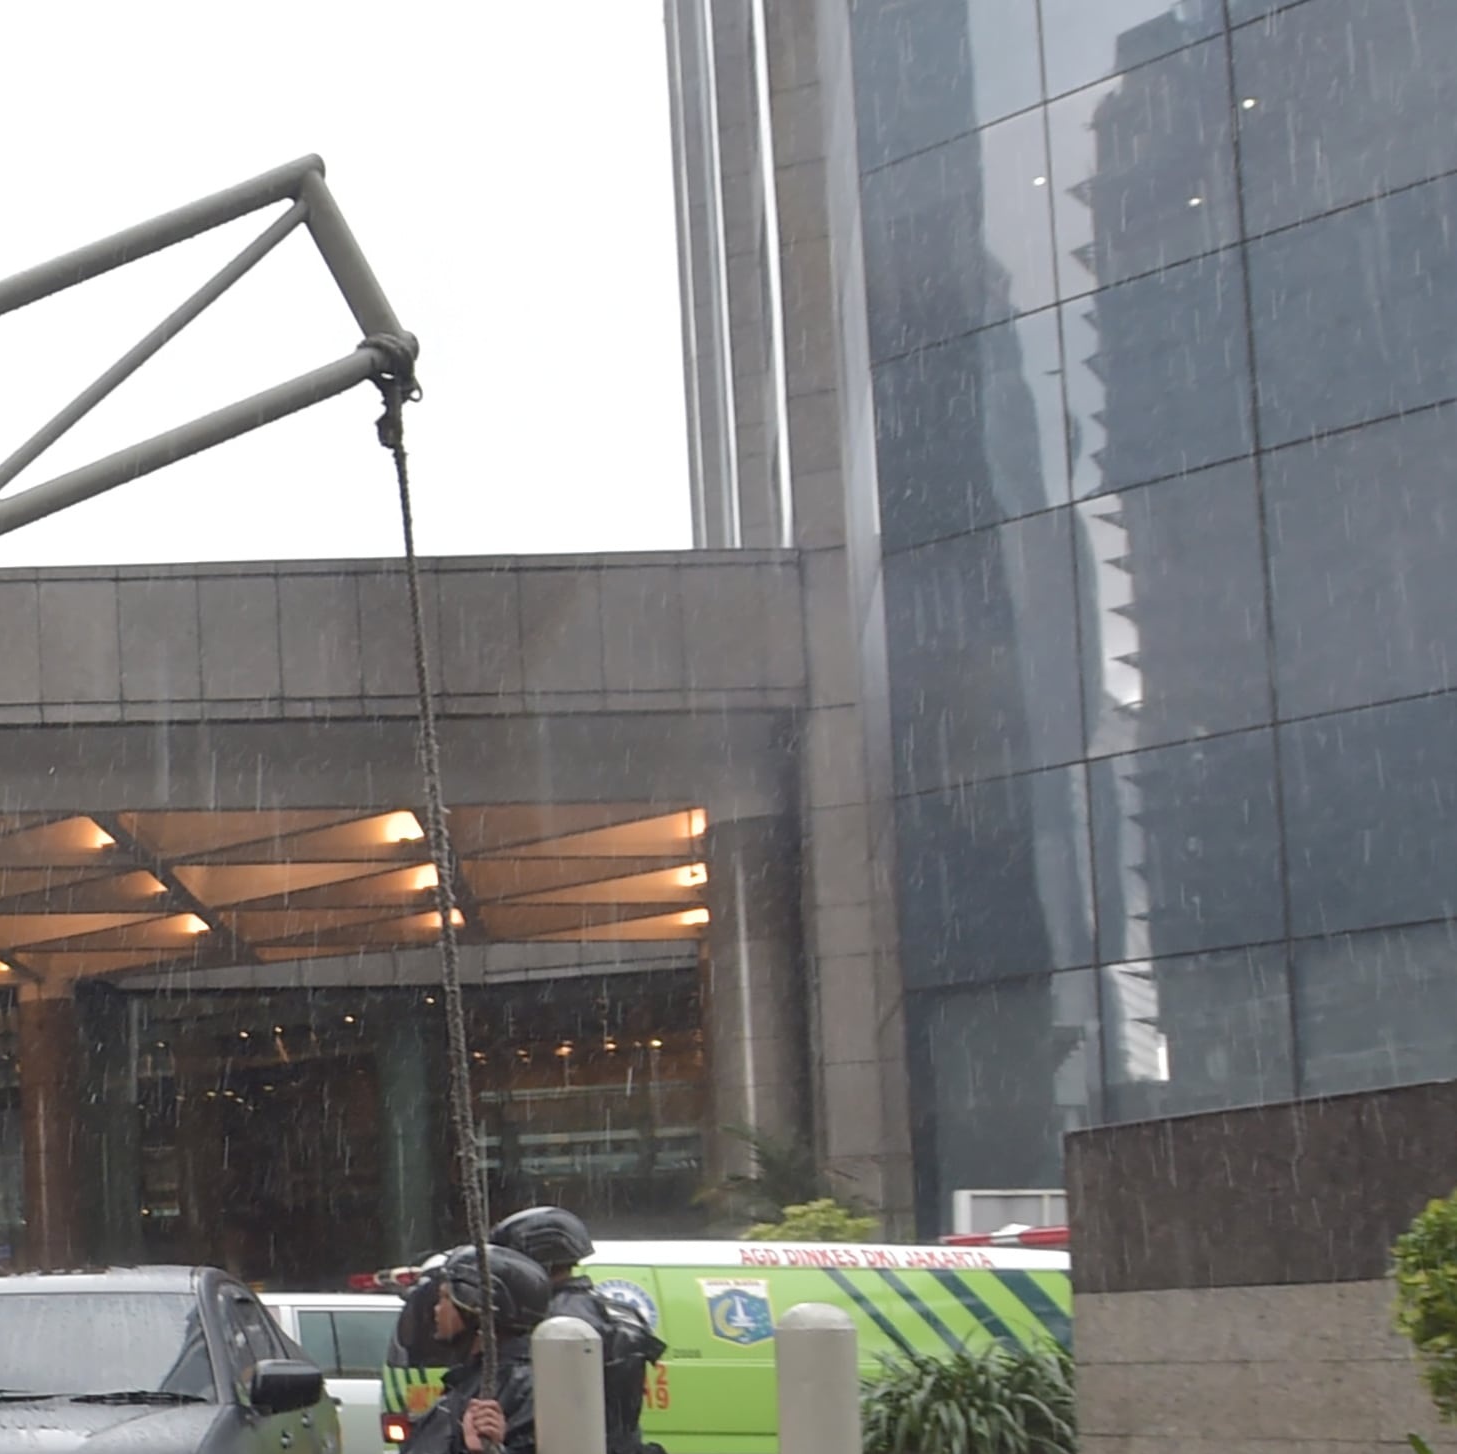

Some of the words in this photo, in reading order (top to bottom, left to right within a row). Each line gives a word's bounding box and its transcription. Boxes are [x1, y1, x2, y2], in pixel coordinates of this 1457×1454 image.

[738, 1248, 781, 1266] AGD
[783, 1249, 860, 1267] DINKES
[861, 1250, 900, 1268] DKI
[905, 1251, 995, 1269] JAKARTA
